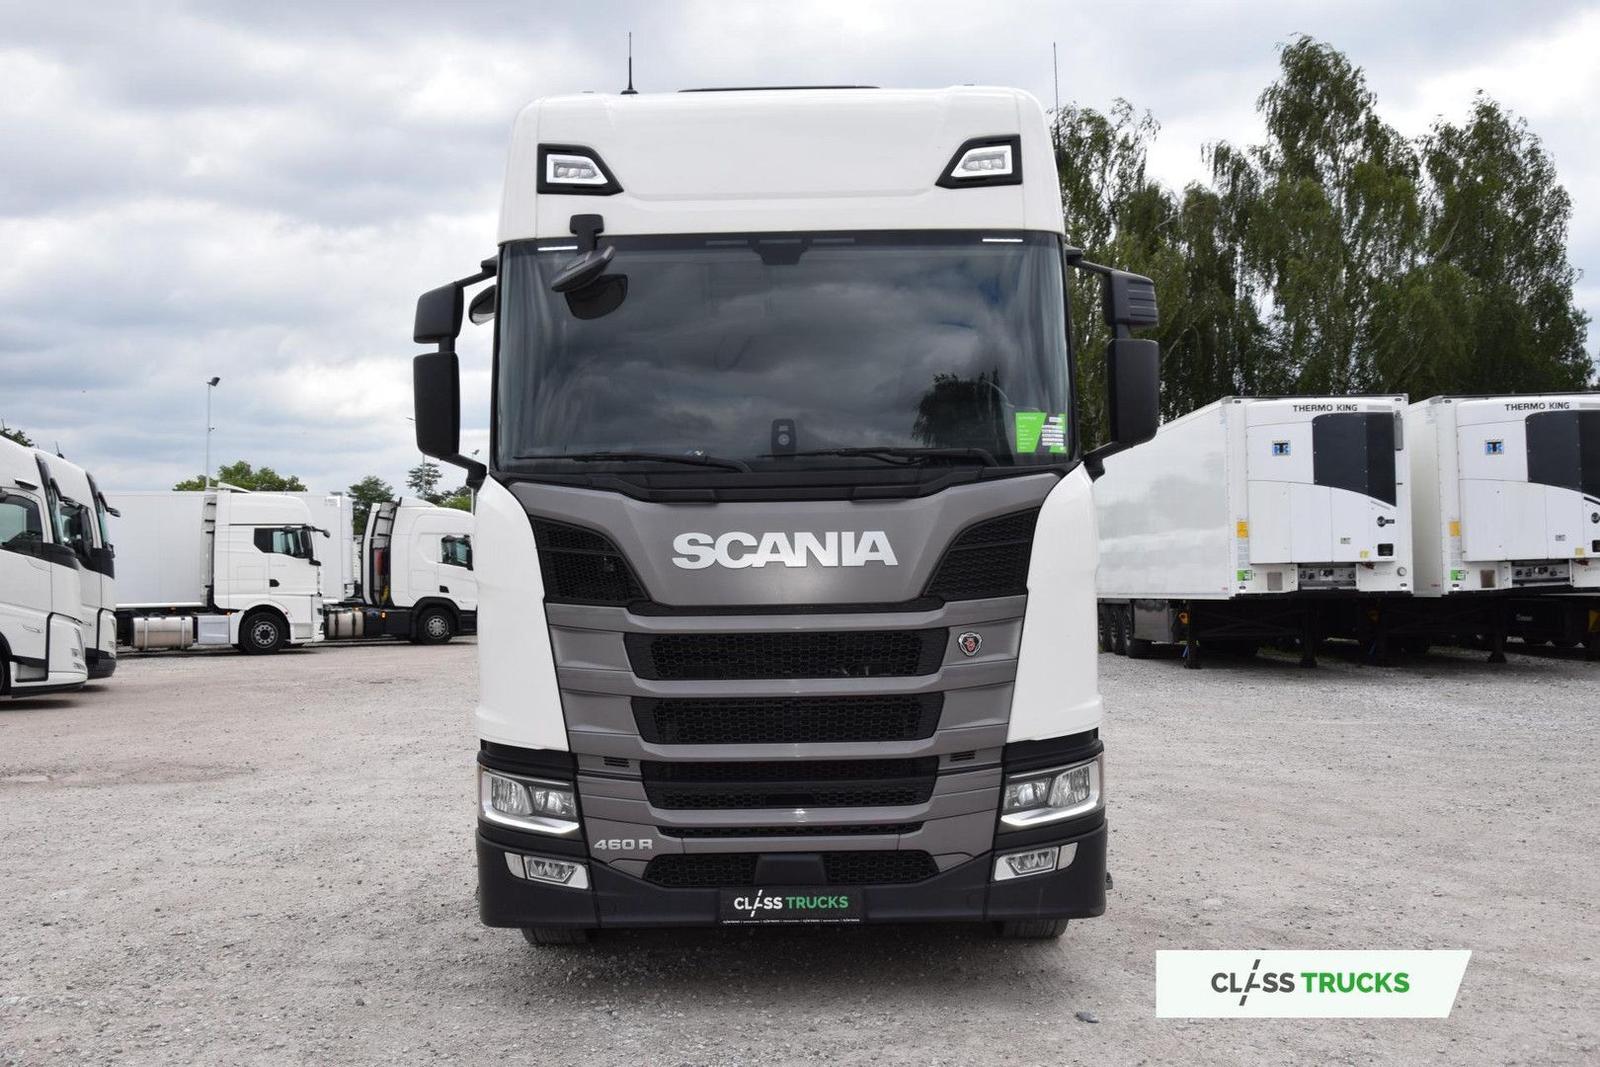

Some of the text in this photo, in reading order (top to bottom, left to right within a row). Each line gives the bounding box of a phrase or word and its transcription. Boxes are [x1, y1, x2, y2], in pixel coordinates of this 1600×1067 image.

[1292, 403, 1358, 413] THERMO KING
[1504, 402, 1570, 411] THERMO KING
[671, 530, 899, 570] SCANIA
[593, 839, 653, 851] 460 R
[733, 889, 849, 917] CLASS TRUCKS
